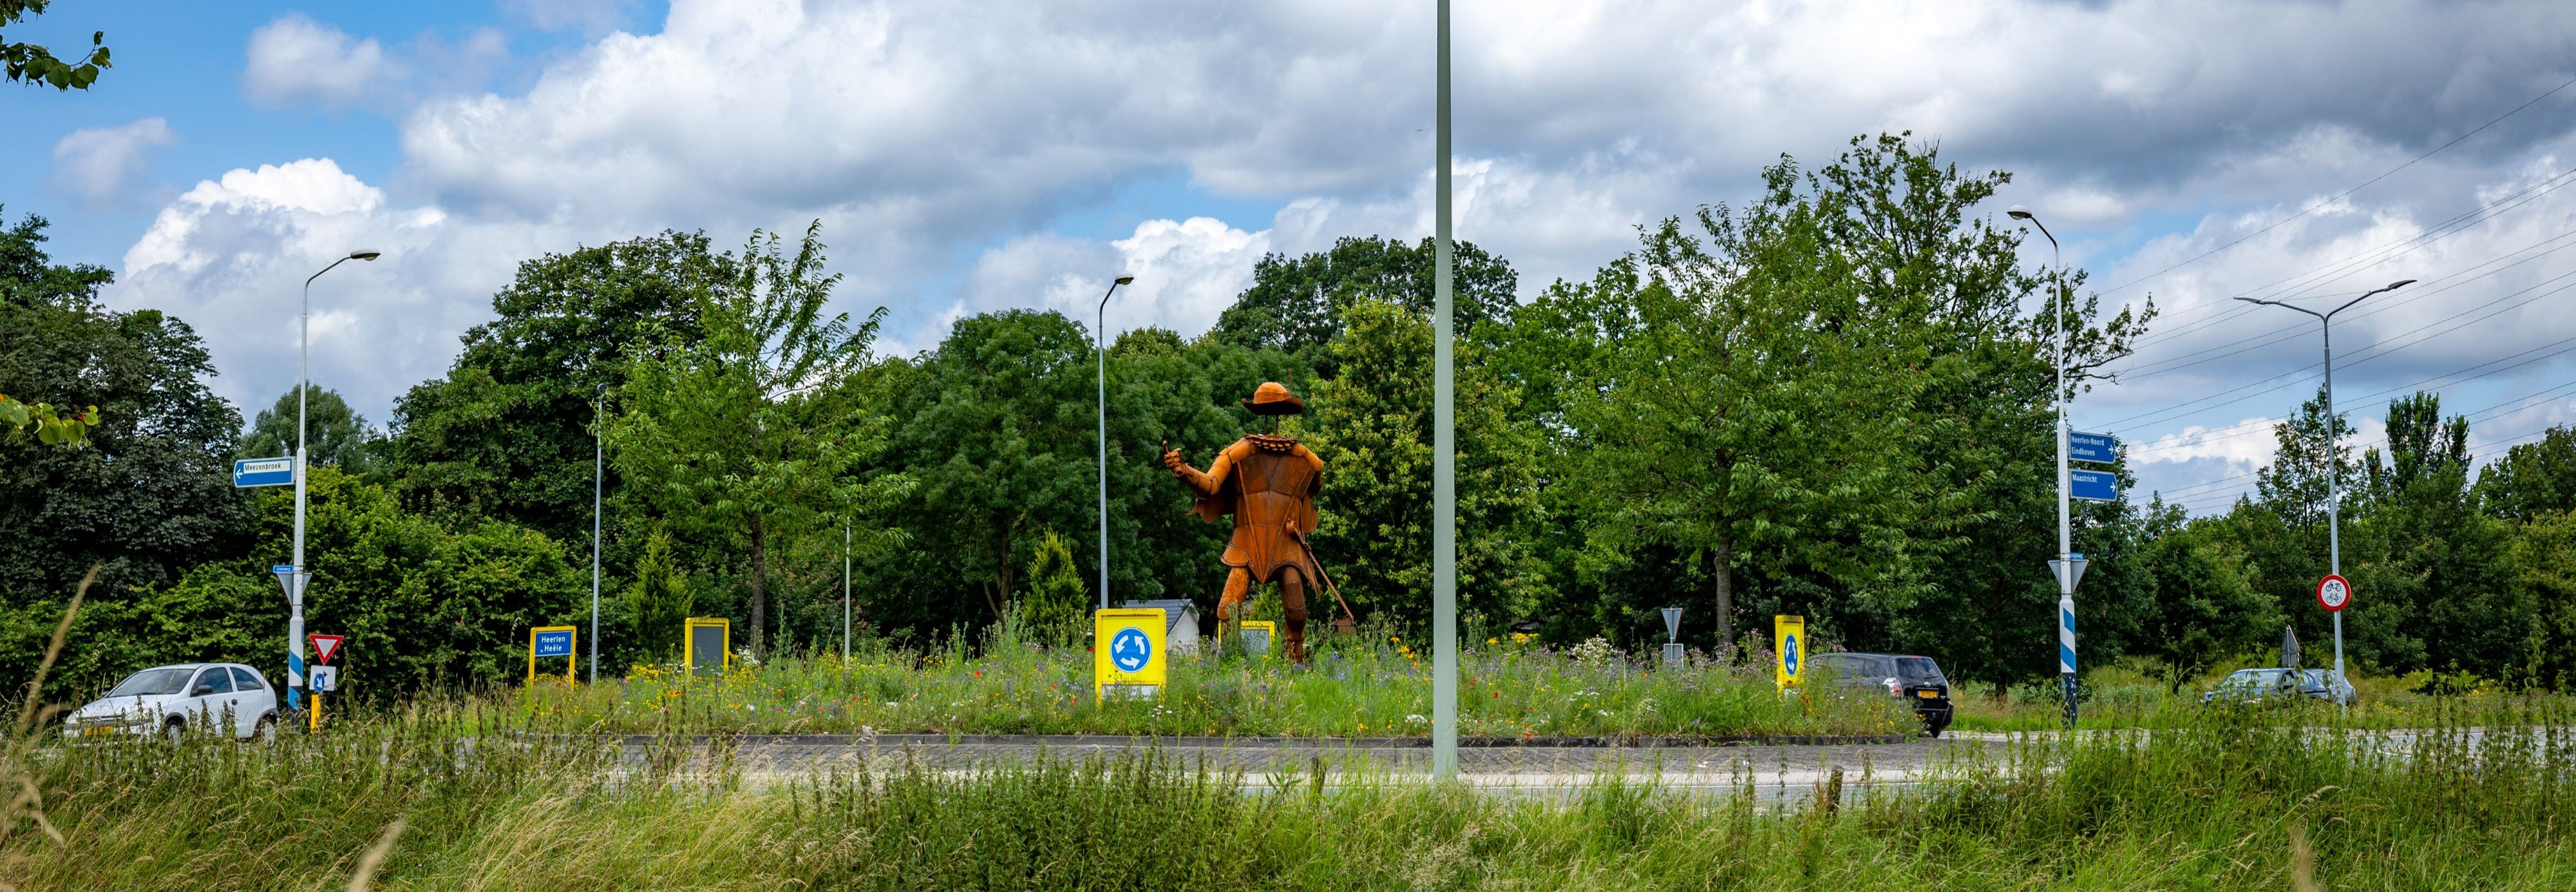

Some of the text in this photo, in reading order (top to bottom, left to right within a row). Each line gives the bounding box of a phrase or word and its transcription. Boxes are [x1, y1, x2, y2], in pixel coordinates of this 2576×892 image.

[2071, 435, 2105, 446] Heerlen-Noord
[2071, 447, 2095, 456] Eindhoven
[245, 462, 281, 471] Meezenbroek
[2072, 473, 2098, 483] Maastricht
[542, 635, 565, 643] Heerlen
